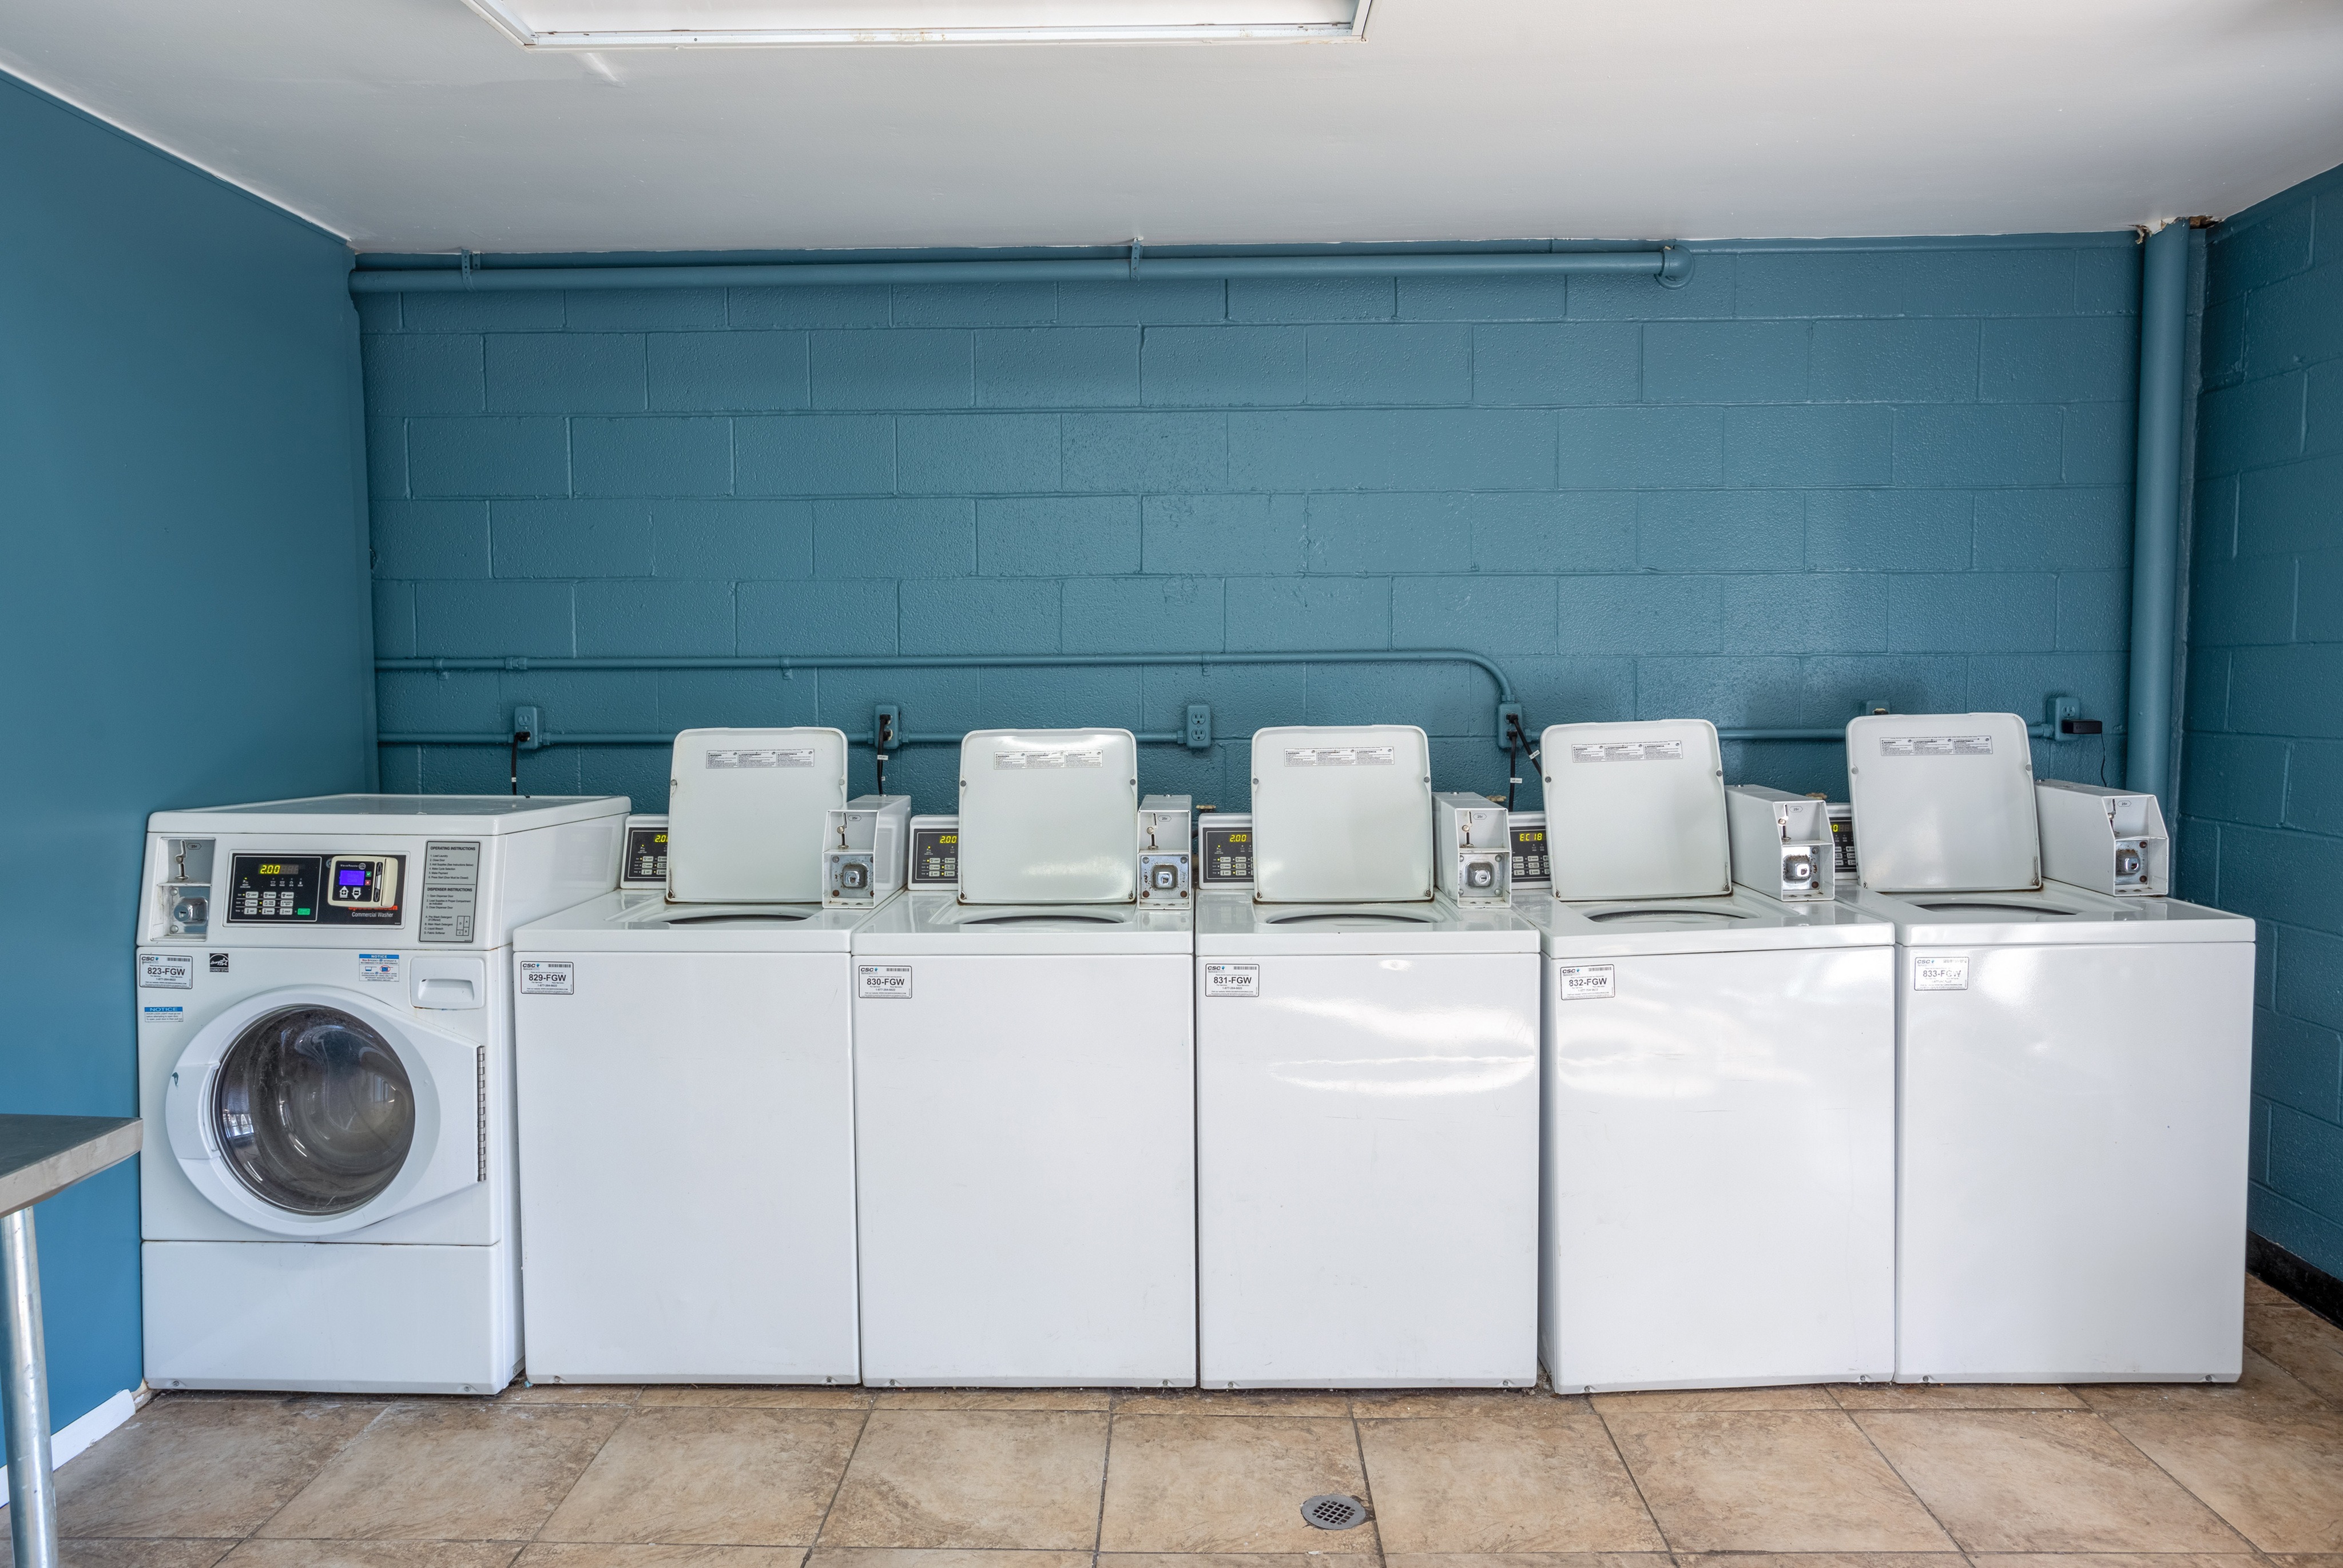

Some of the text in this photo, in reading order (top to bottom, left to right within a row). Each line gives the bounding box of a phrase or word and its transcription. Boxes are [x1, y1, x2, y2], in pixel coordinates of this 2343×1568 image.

[260, 865, 280, 874] 2.00
[147, 967, 185, 976] 823-FGW
[1569, 977, 1607, 987] 832-FGW
